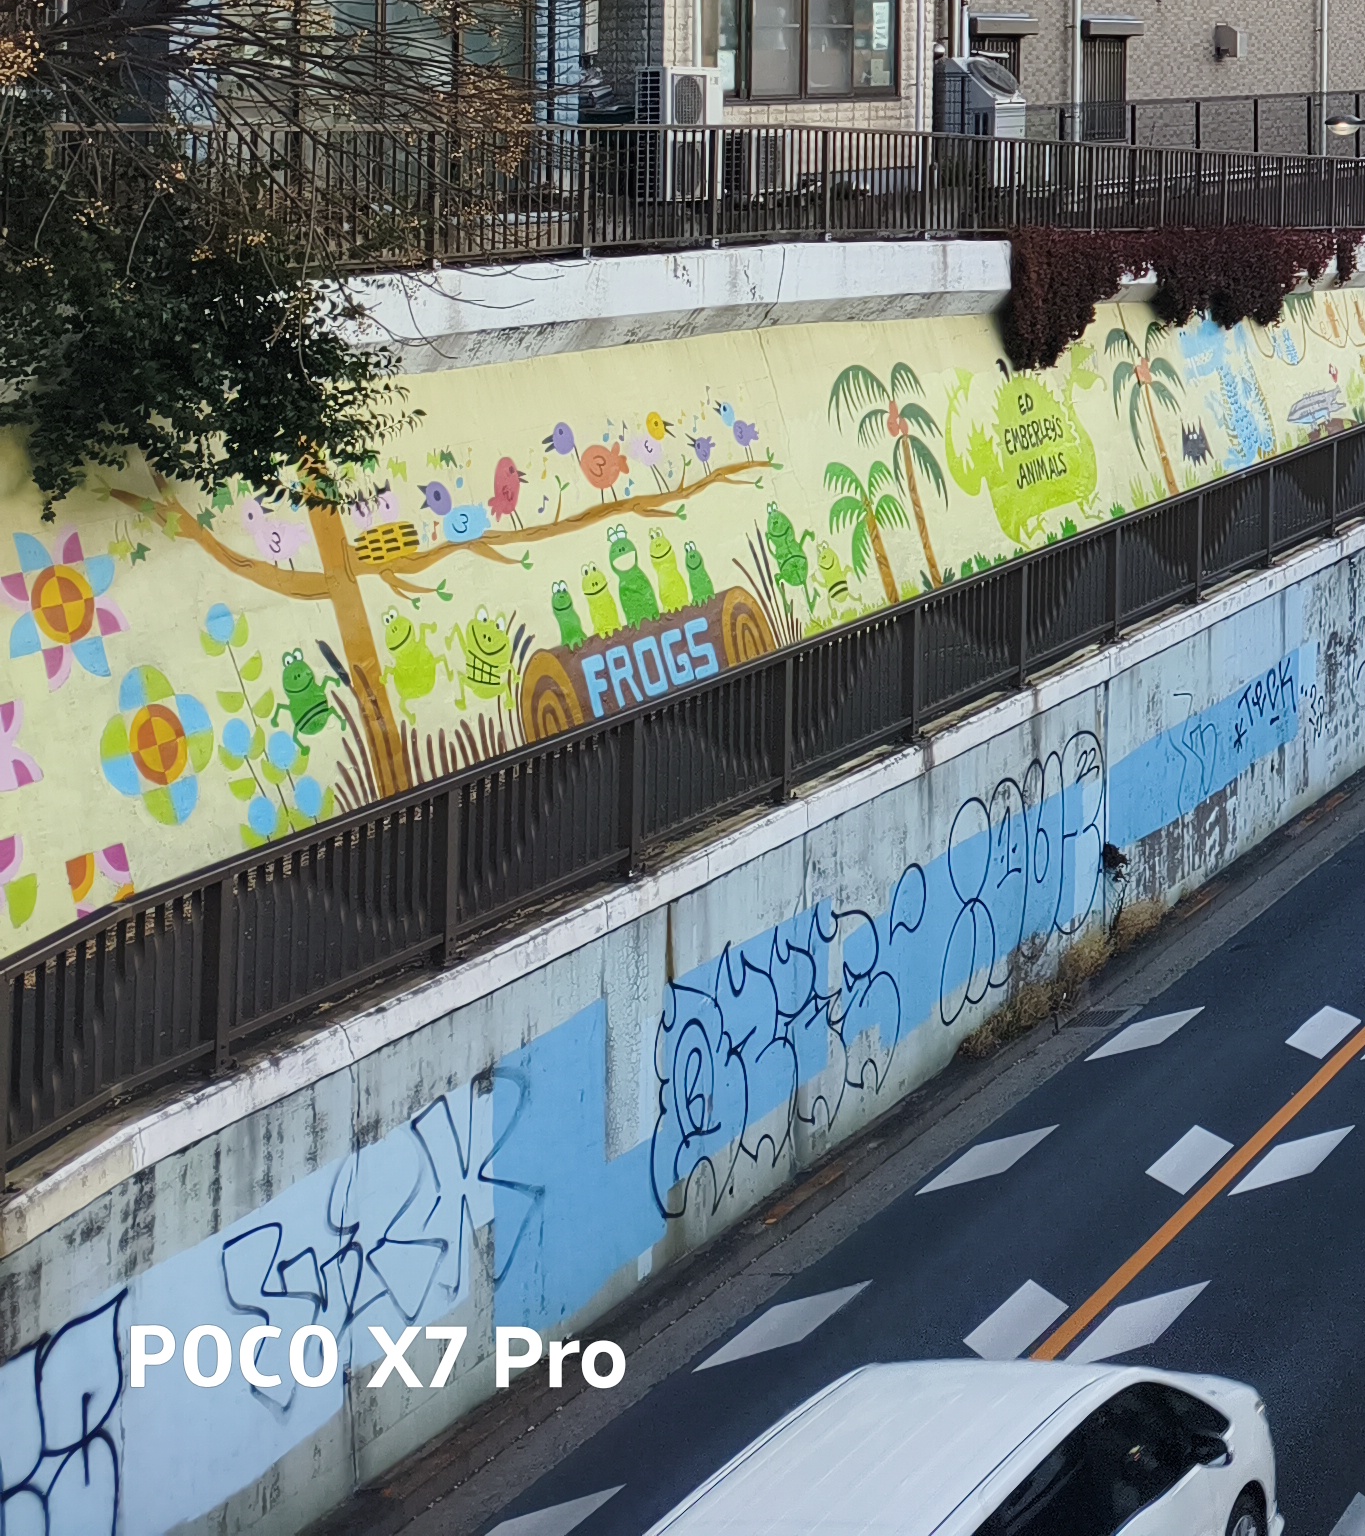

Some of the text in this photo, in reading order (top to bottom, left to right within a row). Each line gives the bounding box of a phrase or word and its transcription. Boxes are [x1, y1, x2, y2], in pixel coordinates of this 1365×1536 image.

[1018, 393, 1034, 415] ED
[1016, 452, 1068, 489] ANIMALS
[581, 617, 719, 718] FROGS
